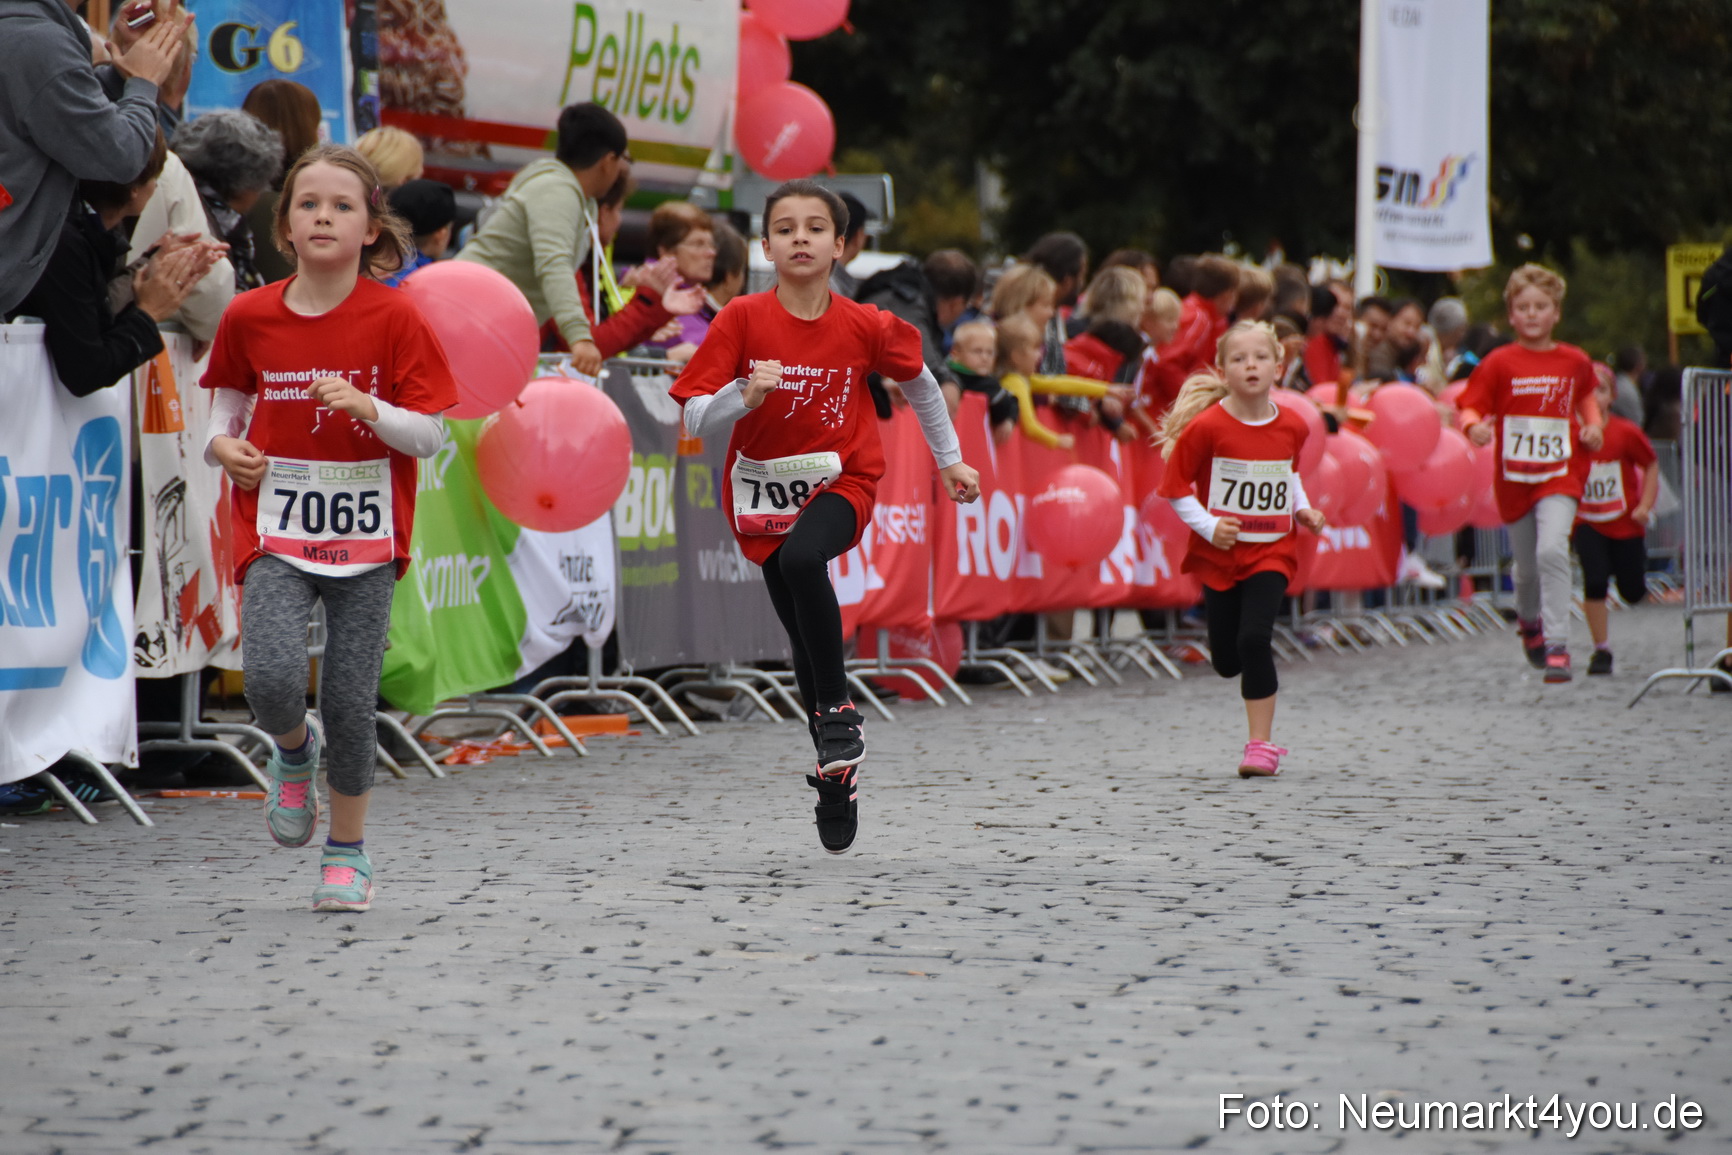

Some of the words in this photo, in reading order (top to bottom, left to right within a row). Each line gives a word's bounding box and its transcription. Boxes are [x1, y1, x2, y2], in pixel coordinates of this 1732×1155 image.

[208, 20, 304, 74] G6
[559, 2, 701, 125] Pellets
[261, 367, 343, 382] Neumarkter
[263, 386, 310, 401] Stadtla
[1511, 432, 1564, 461] 7153
[271, 470, 311, 482] NeuerMarkt
[319, 465, 381, 480] BOCK
[774, 456, 831, 474] BOCK
[1221, 477, 1287, 511] 7098
[274, 488, 381, 535] 7065
[956, 489, 1044, 581] ROL
[302, 546, 349, 564] Maya
